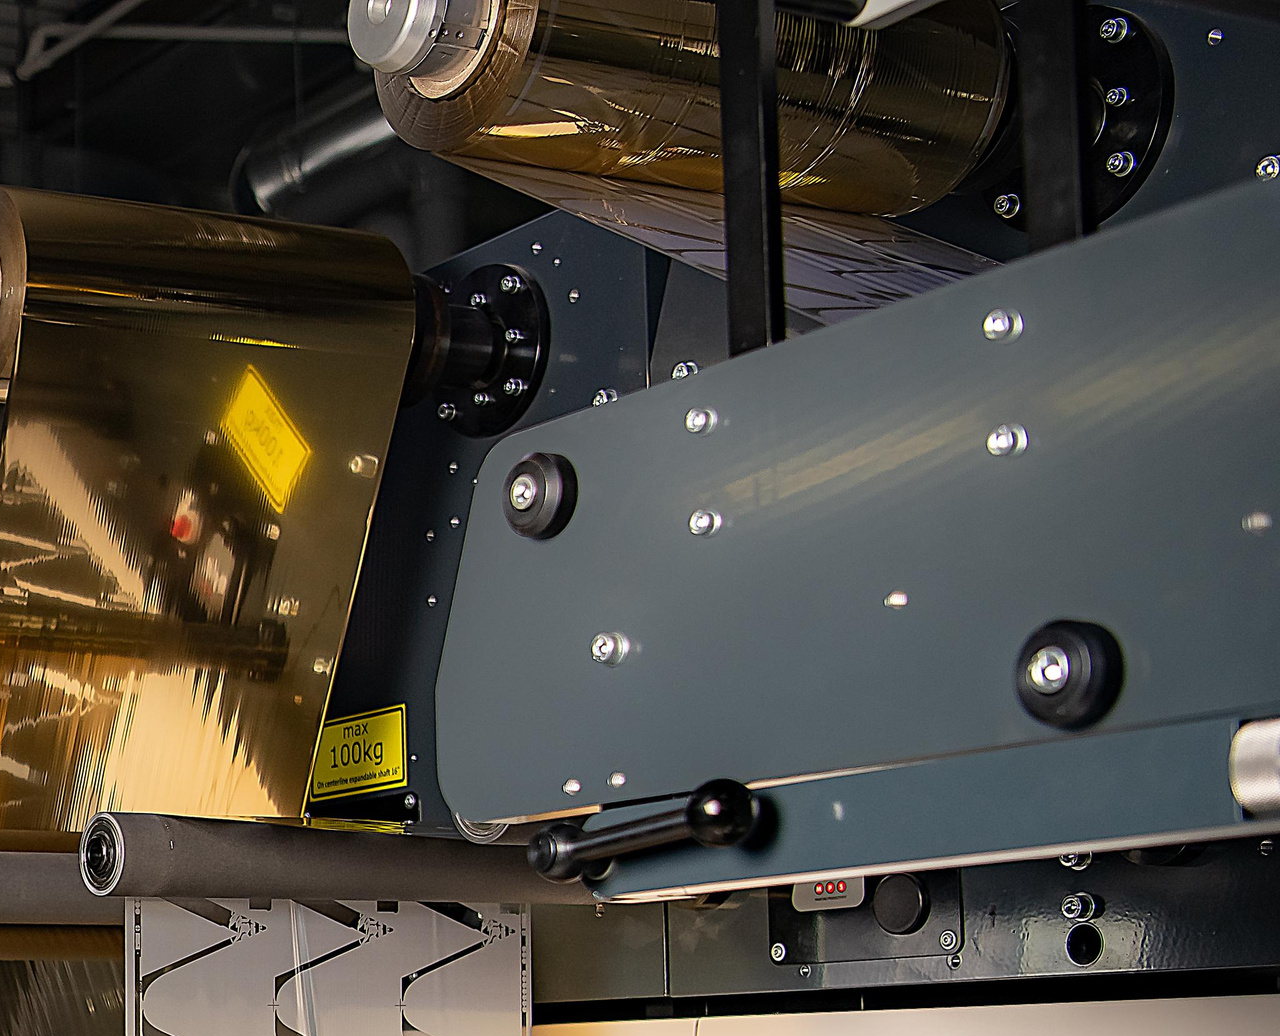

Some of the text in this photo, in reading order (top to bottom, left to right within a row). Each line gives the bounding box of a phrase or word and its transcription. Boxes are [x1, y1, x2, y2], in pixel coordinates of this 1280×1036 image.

[343, 722, 368, 739] max
[330, 739, 383, 769] 100kg
[325, 777, 348, 788] centerline
[349, 771, 377, 784] expandable
[378, 768, 391, 778] shaft
[815, 881, 845, 894] MPS
